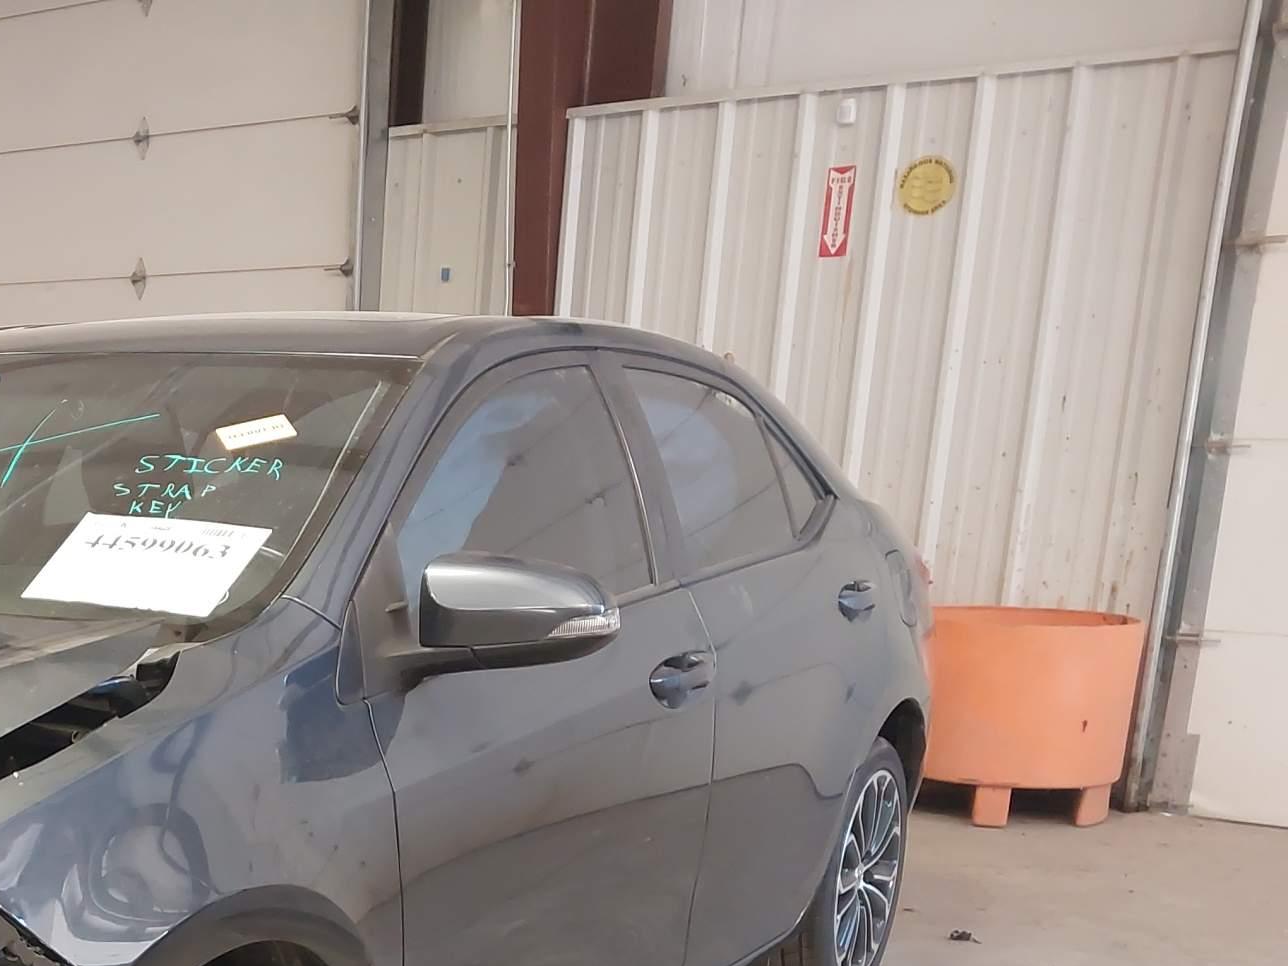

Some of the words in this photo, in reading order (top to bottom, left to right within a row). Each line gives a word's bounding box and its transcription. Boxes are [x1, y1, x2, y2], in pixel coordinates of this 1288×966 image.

[135, 454, 284, 481] STICKER
[113, 482, 217, 500] STRAP
[129, 500, 182, 519] KEY
[84, 534, 232, 559] 44599063
